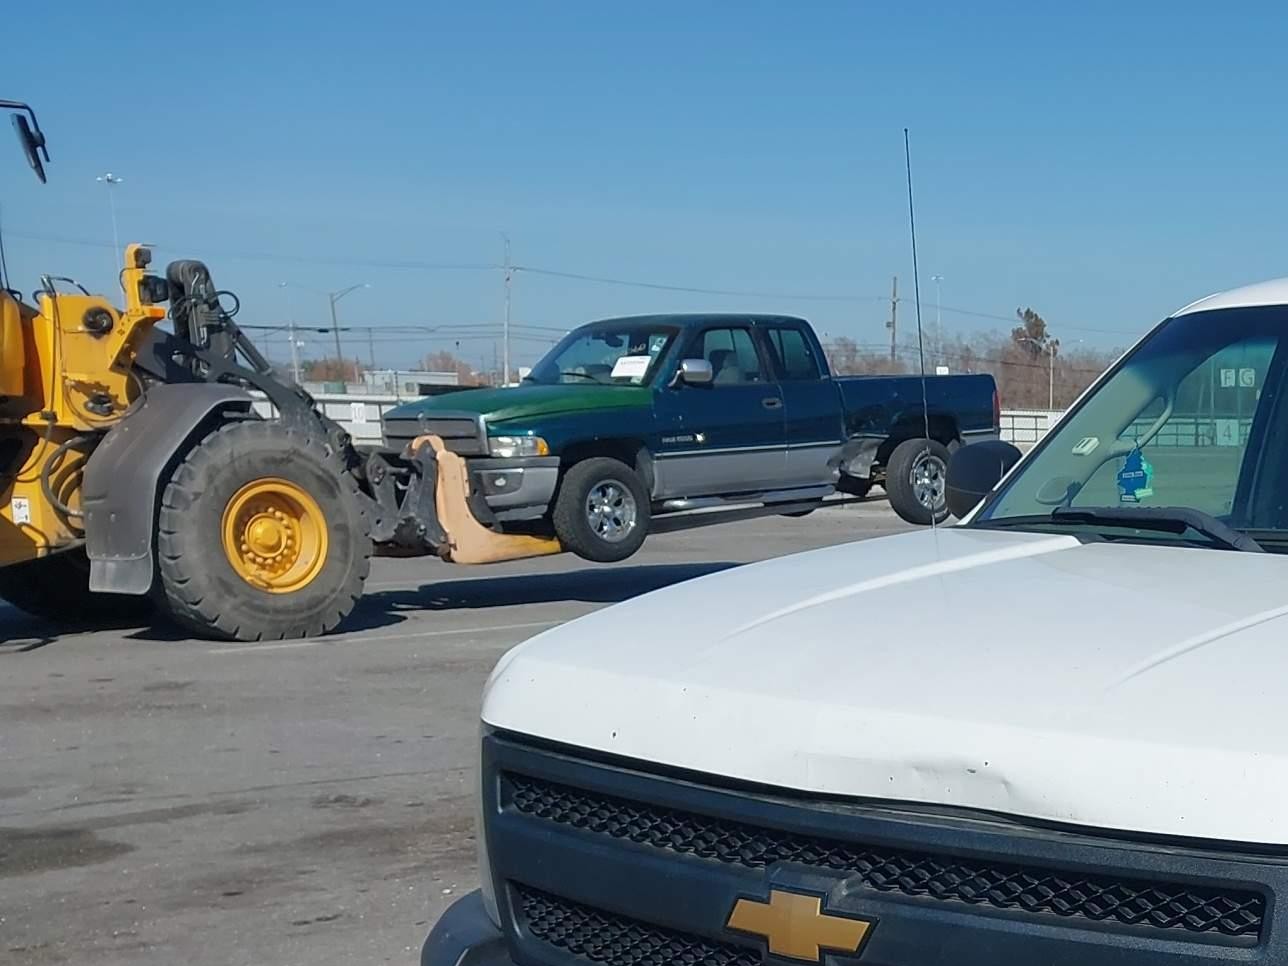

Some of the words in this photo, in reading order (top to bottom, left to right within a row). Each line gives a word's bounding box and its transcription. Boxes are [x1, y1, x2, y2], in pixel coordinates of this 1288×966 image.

[1223, 369, 1233, 386] F
[1240, 369, 1254, 386] G
[1223, 423, 1233, 441] 4
